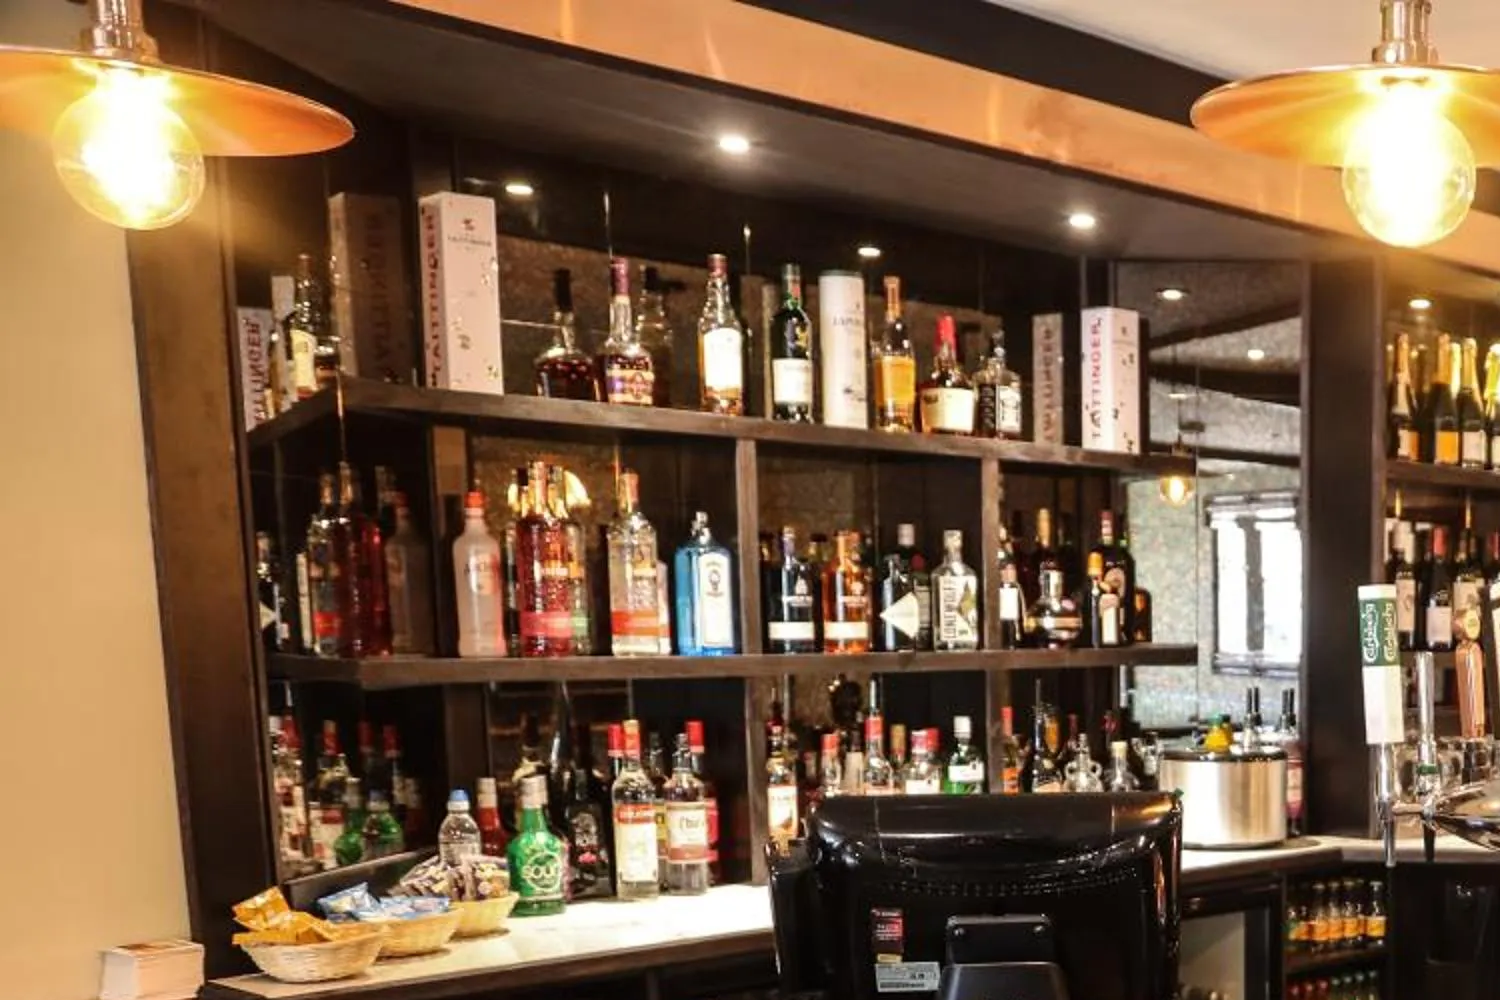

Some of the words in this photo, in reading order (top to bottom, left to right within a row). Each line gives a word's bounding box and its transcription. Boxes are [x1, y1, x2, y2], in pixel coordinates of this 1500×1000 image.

[425, 213, 442, 373] TAITTINGER
[1091, 323, 1101, 440] TAITTINGER
[1362, 603, 1379, 663] Carlsberg
